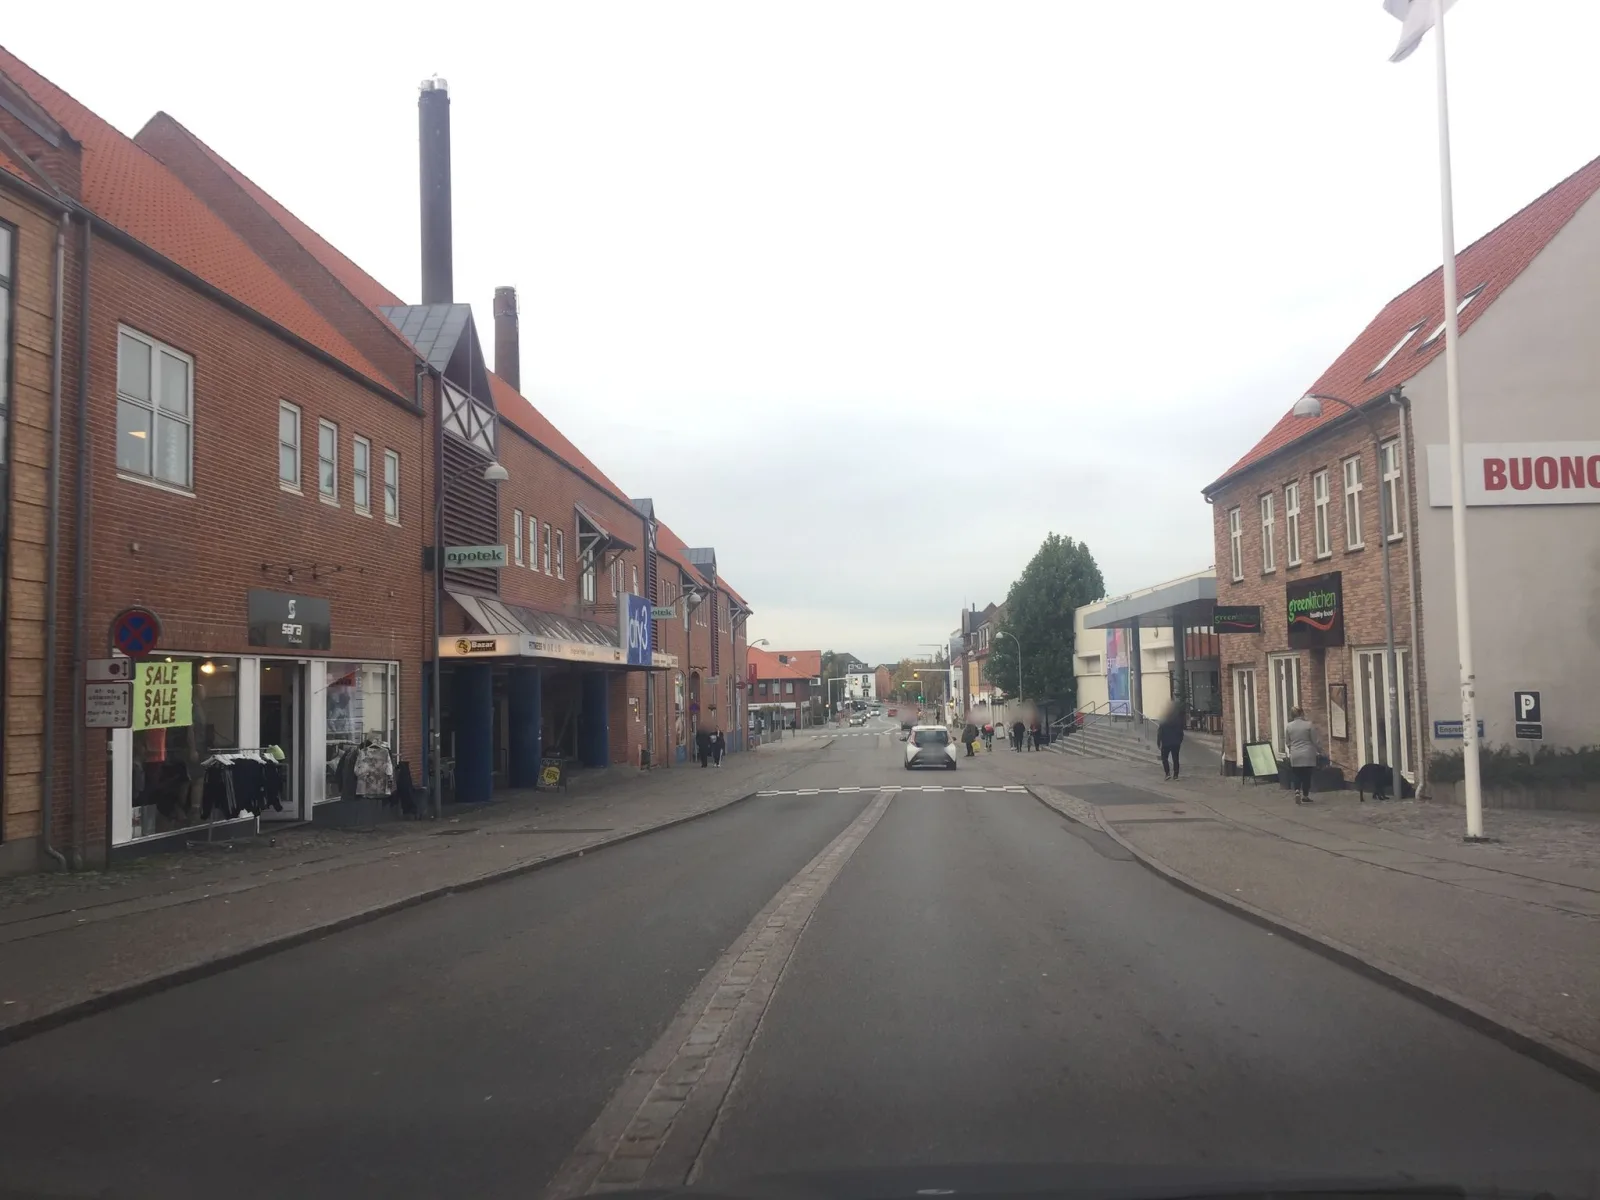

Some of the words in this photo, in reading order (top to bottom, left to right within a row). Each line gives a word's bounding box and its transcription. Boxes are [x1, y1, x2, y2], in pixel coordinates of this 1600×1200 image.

[447, 549, 503, 565] apotek
[281, 623, 302, 635] sara
[145, 665, 179, 686] SALE
[144, 687, 178, 707] SALE
[1520, 694, 1535, 719] P
[144, 706, 176, 726] SALE
